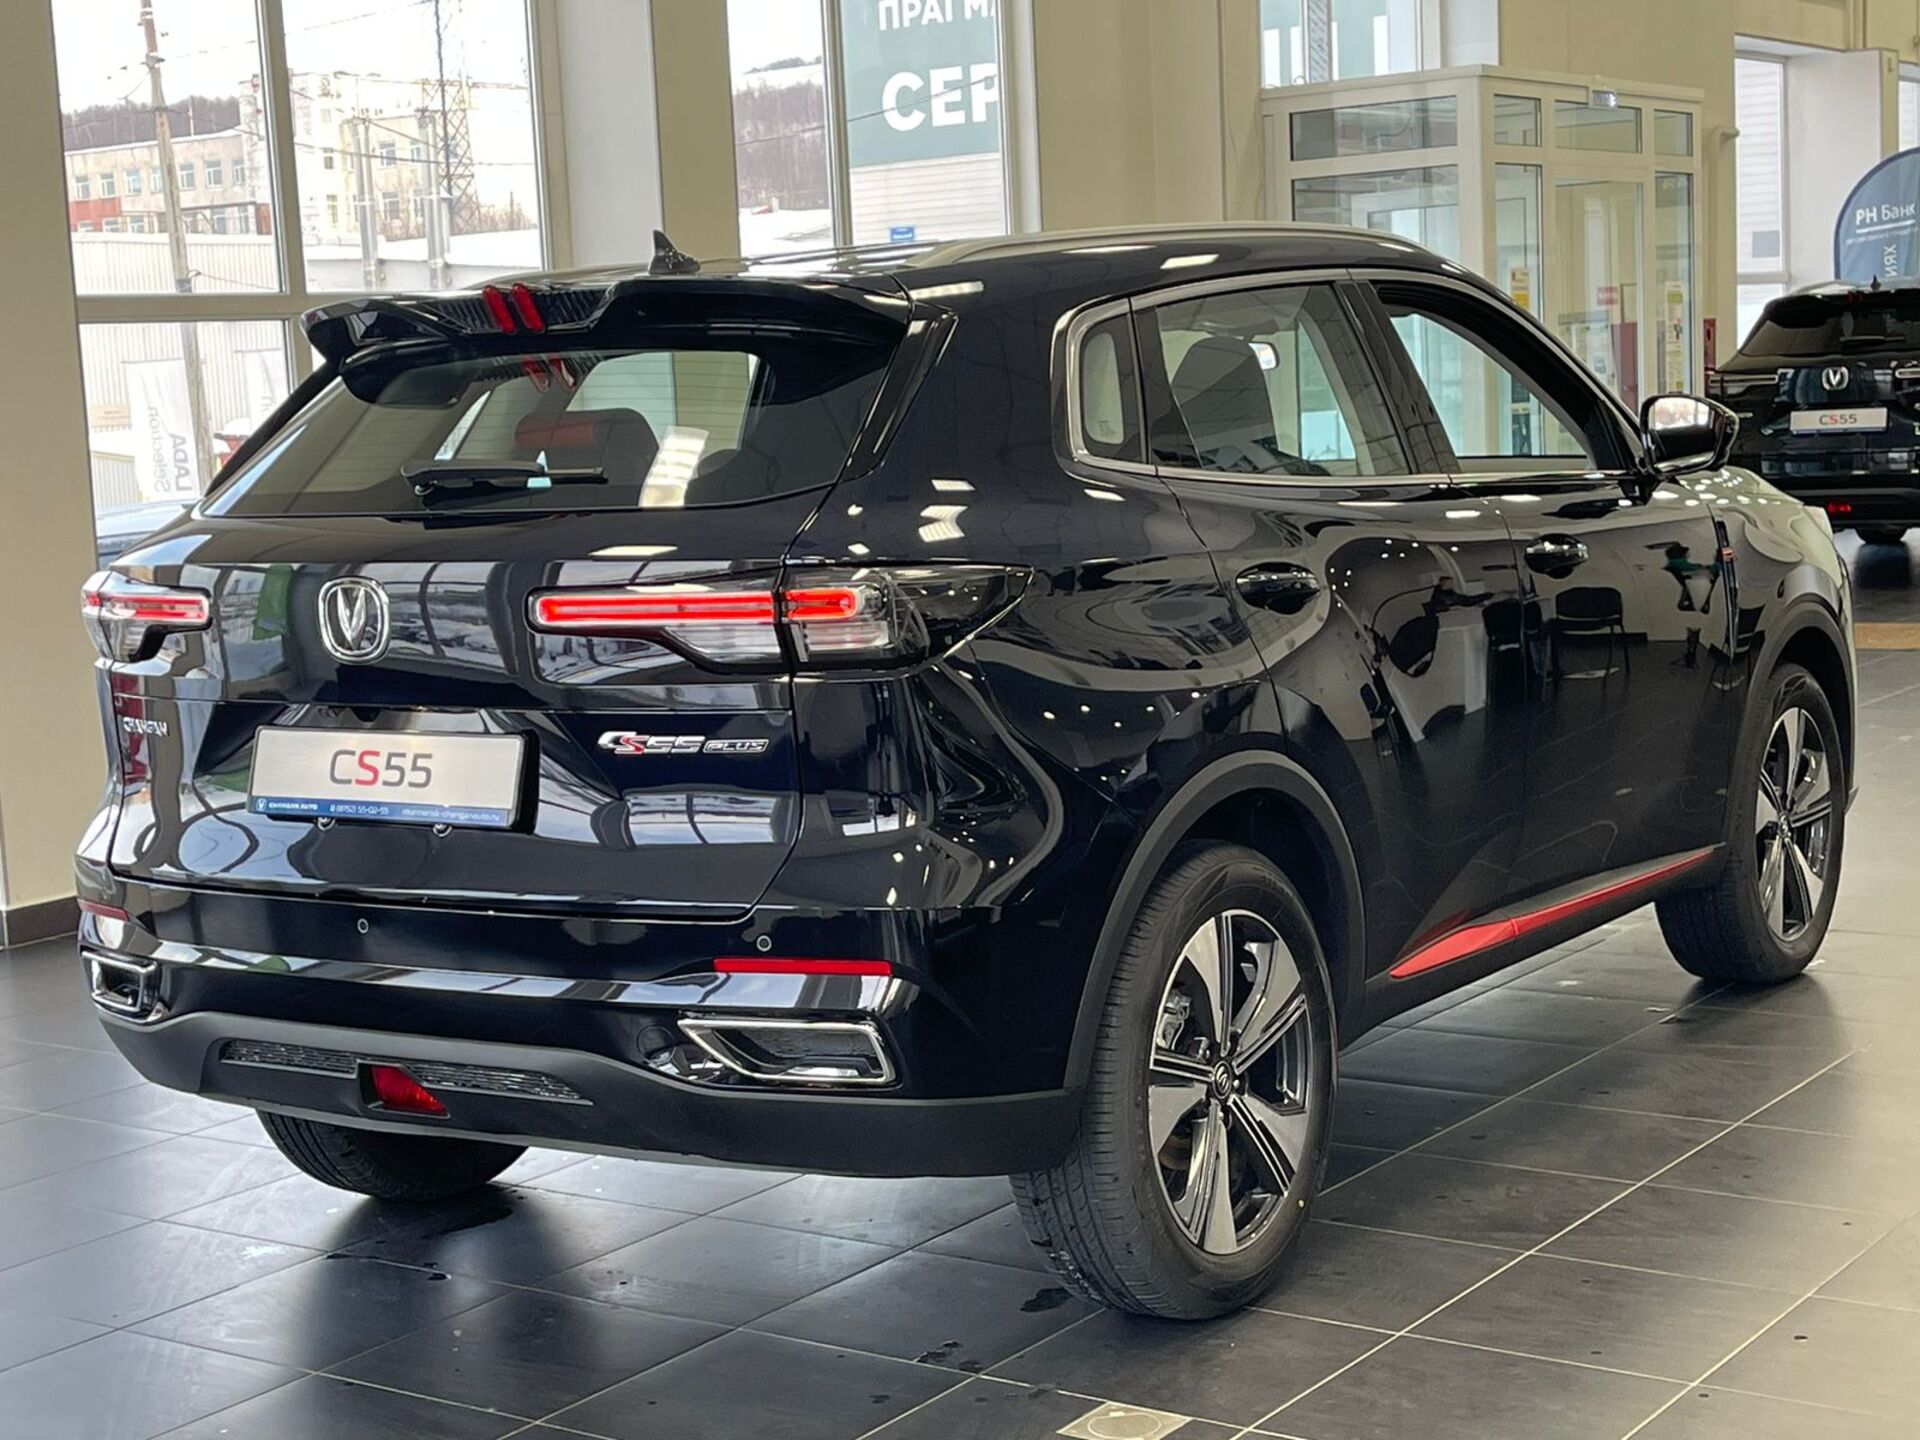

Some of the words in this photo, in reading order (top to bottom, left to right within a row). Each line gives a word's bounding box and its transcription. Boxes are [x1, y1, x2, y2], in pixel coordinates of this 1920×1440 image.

[1856, 206, 1877, 226] РН
[1881, 203, 1915, 221] Банк
[1819, 413, 1858, 426] CS55
[598, 731, 706, 755] CS55
[705, 741, 766, 752] PLUS
[329, 749, 433, 788] CS55
